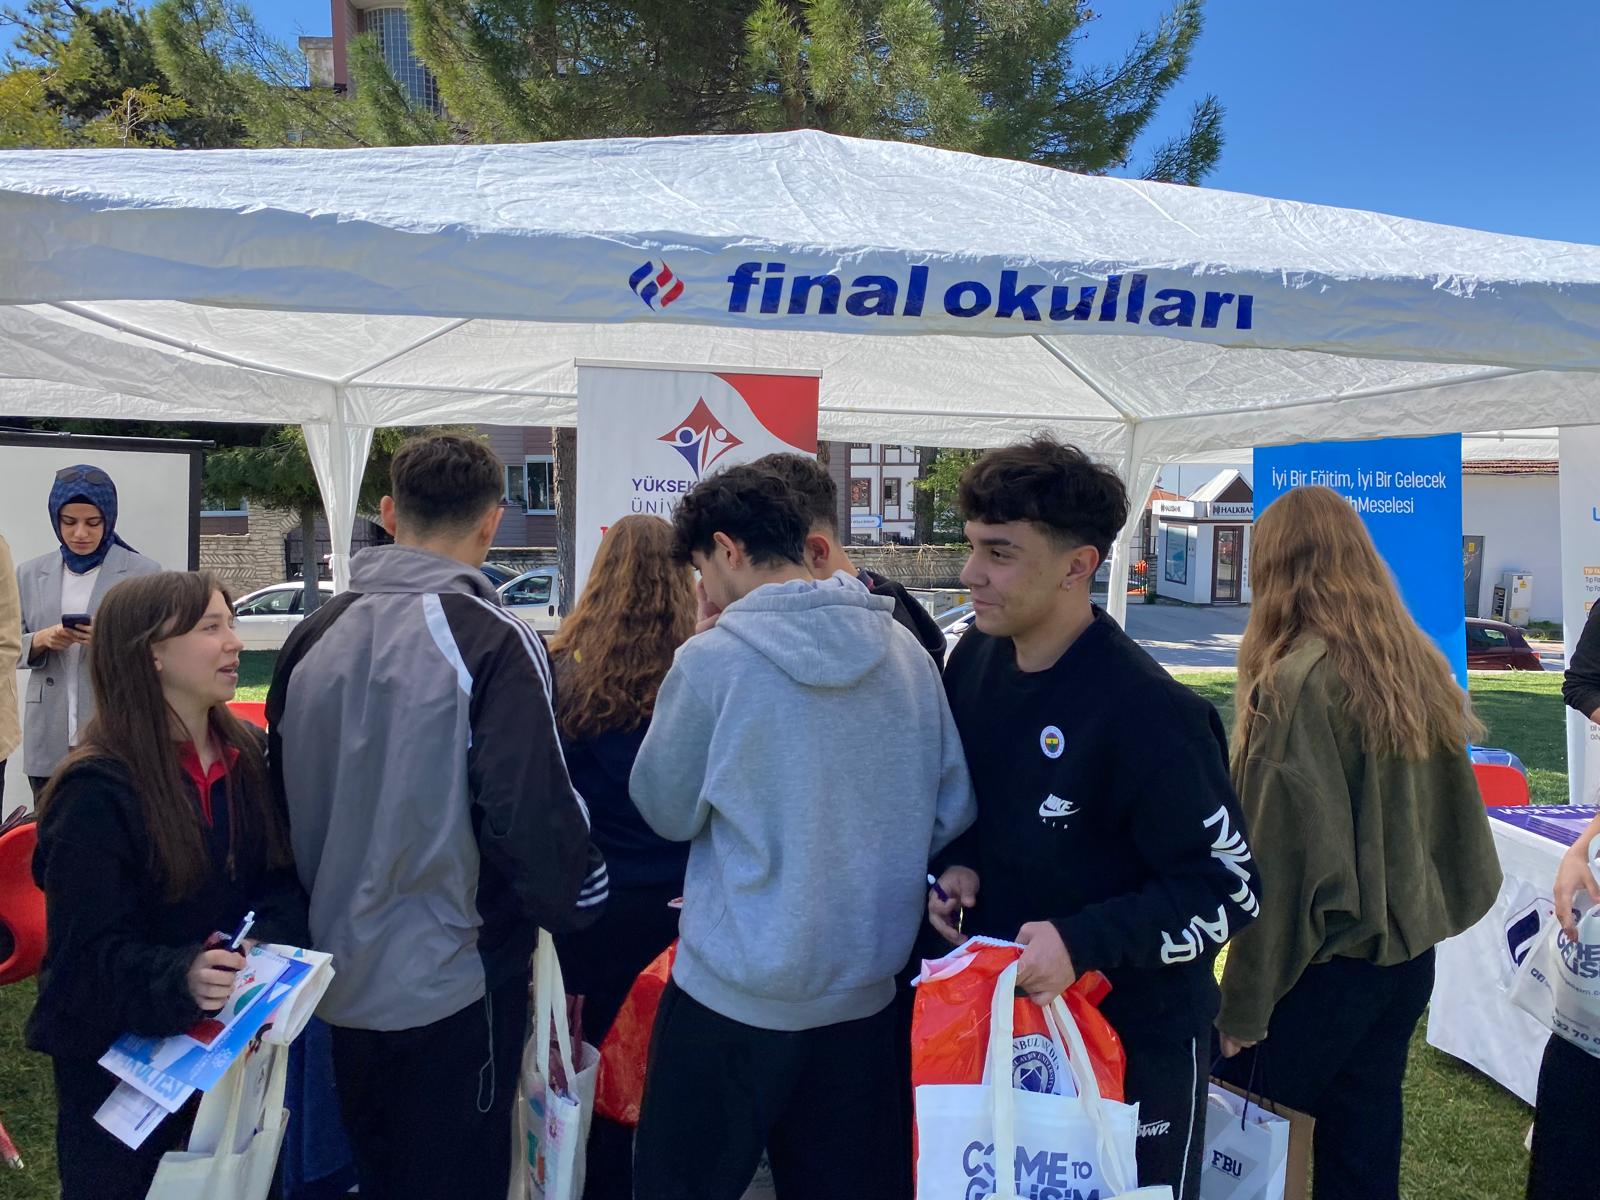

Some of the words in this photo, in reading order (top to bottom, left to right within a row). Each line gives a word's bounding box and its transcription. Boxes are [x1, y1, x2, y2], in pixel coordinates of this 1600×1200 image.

[728, 262, 928, 317] final
[942, 269, 1254, 330] okulları
[1272, 466, 1287, 490] İyi
[1290, 470, 1307, 487] Bir
[1358, 467, 1373, 491] İyi
[1376, 470, 1392, 488] Bir
[1395, 471, 1447, 489] Gelecek
[1072, 1161, 1092, 1179] TO
[1211, 1150, 1242, 1177] FBU
